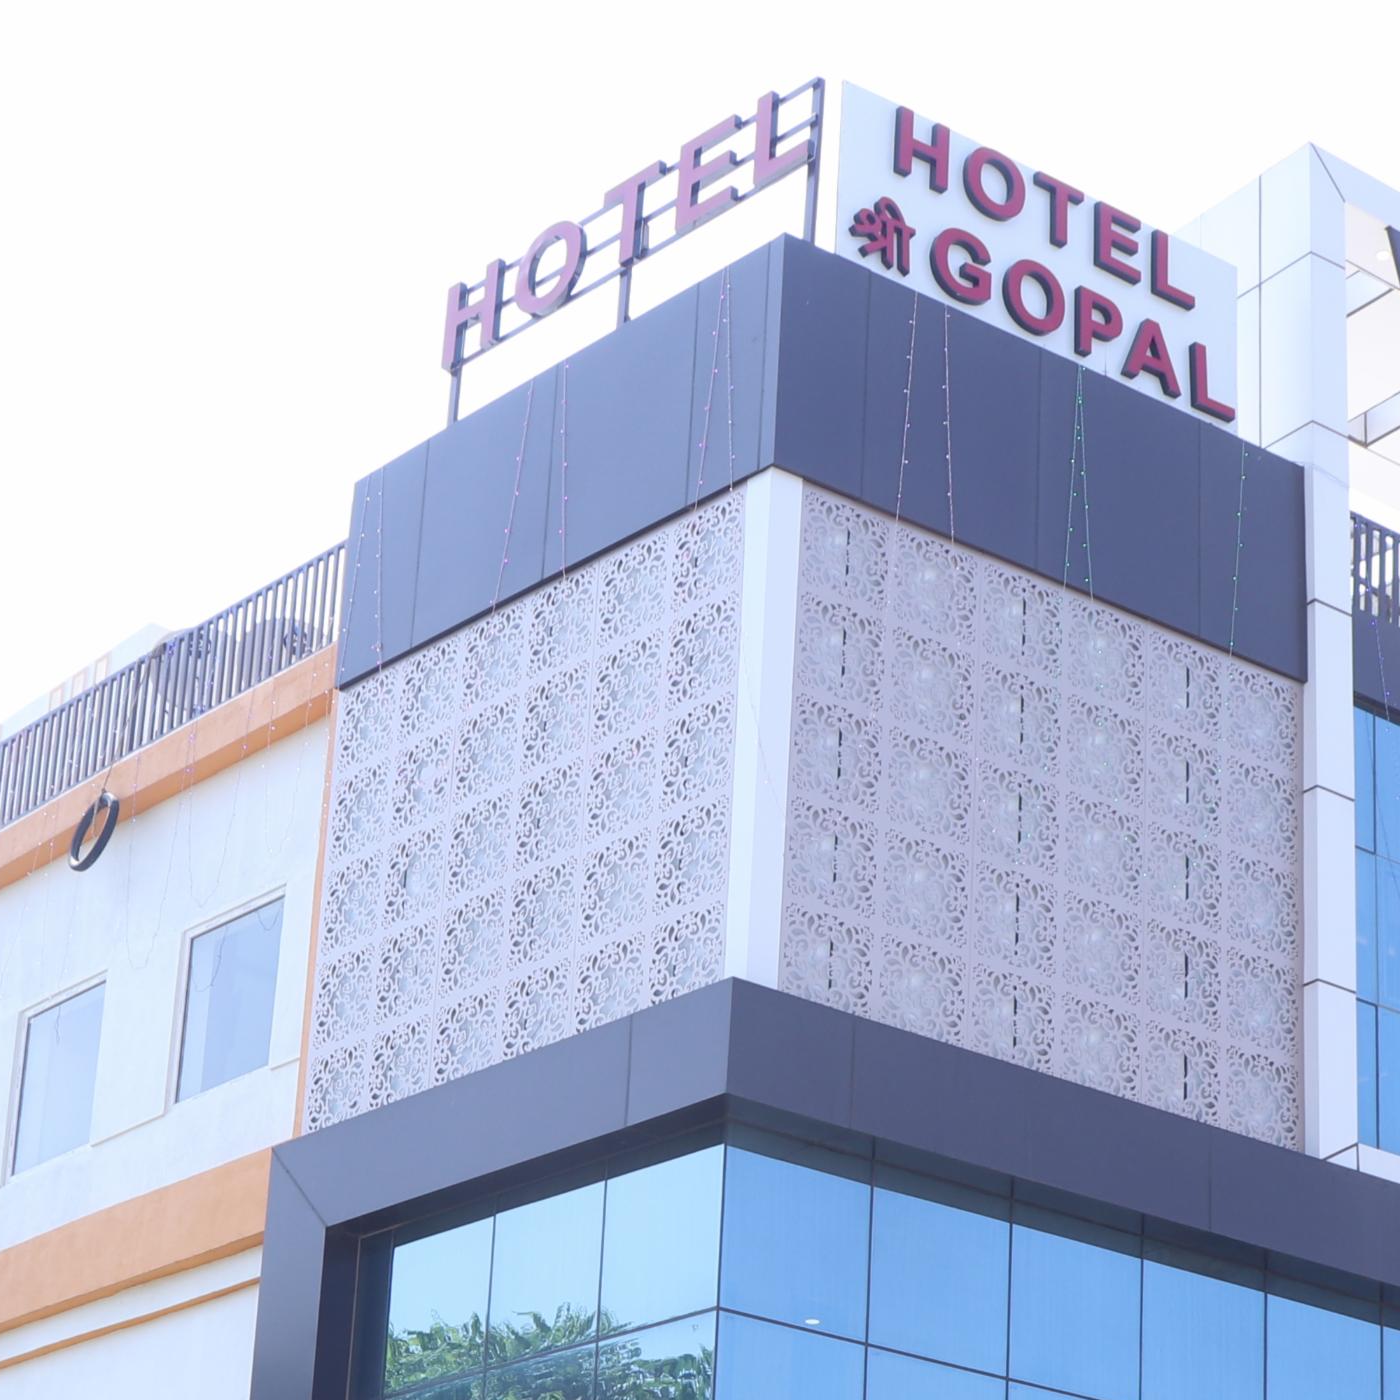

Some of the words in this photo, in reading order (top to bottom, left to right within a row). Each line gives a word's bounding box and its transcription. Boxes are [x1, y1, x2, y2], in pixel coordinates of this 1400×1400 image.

[442, 90, 814, 372] HOTEL
[850, 196, 916, 276] श्री
[929, 227, 1235, 423] GOPAL
[894, 106, 1196, 309] HOTEL
